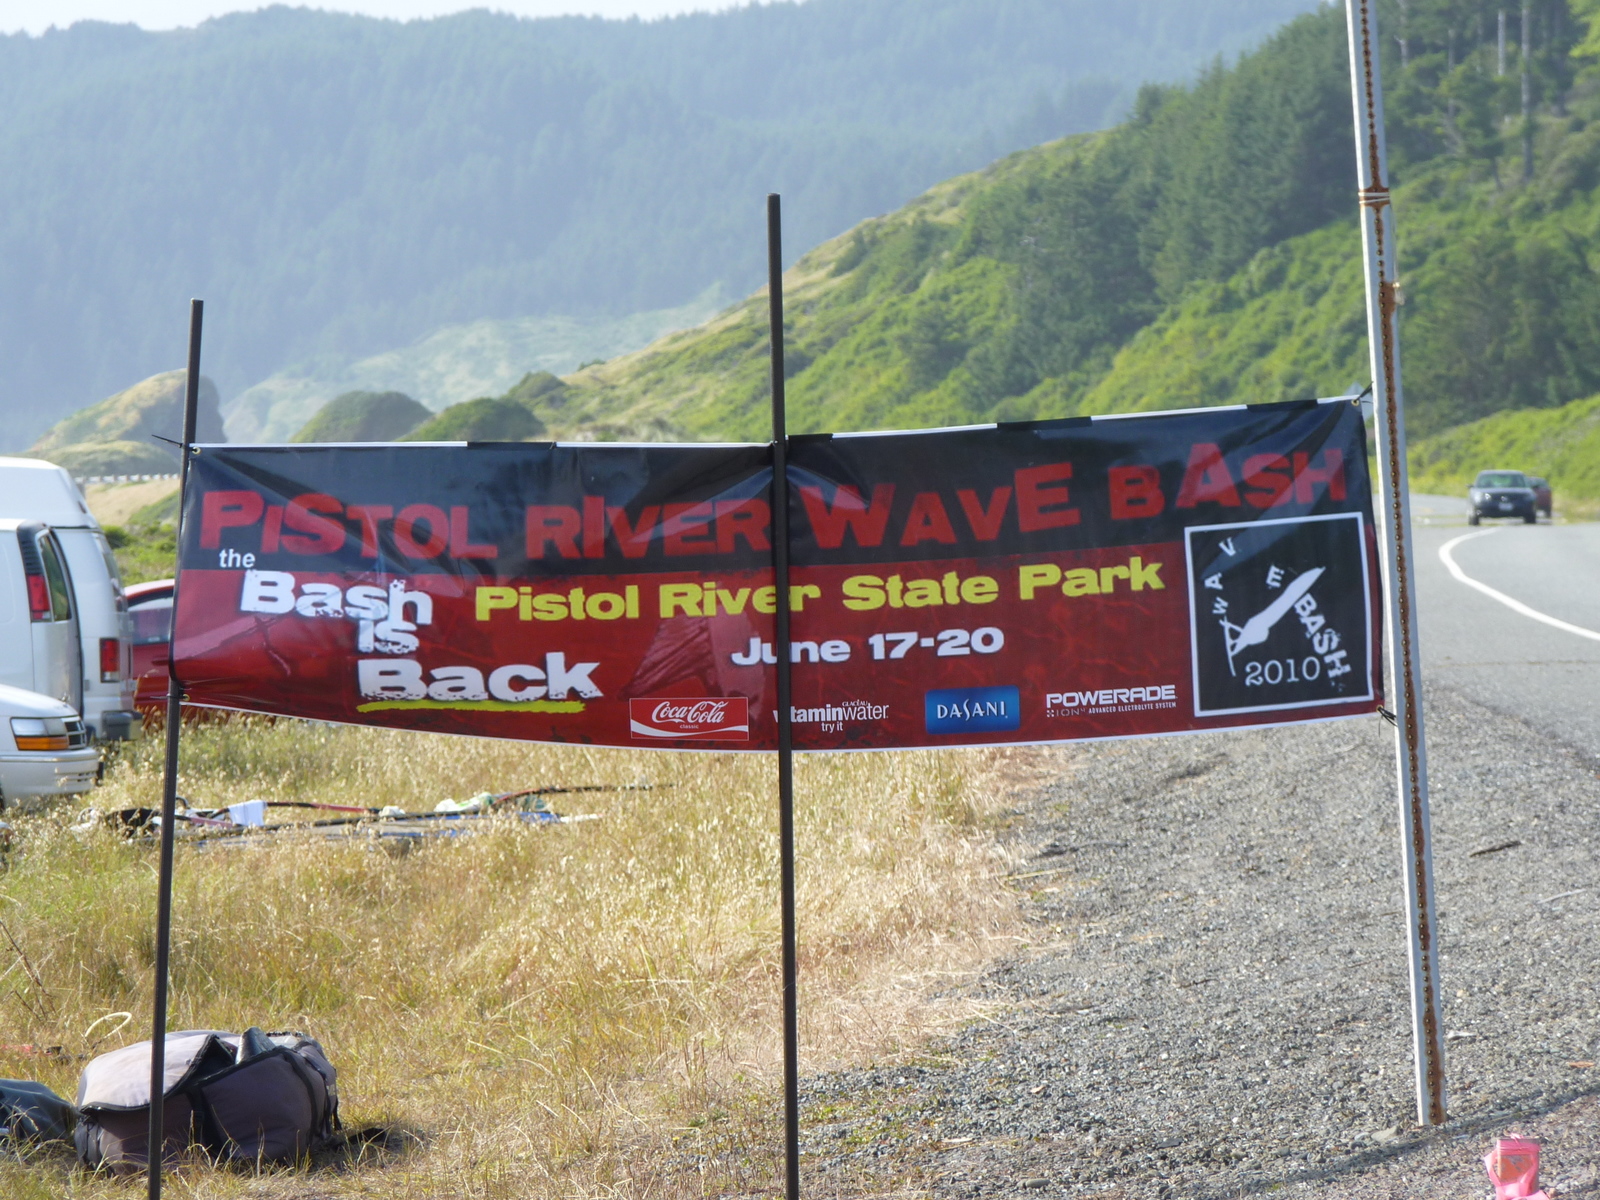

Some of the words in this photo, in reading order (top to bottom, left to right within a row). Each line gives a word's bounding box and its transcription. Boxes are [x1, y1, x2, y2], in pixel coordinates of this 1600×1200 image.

[201, 491, 498, 560] PISTOL
[526, 495, 772, 560] RIVER
[800, 462, 1081, 549] WAVE
[1108, 442, 1347, 520] BASH
[219, 549, 256, 568] the
[240, 569, 433, 626] Bash
[475, 584, 639, 622] Pistol
[659, 581, 821, 619] River
[842, 571, 999, 611] State
[1019, 556, 1165, 600] Park
[731, 637, 851, 666] June
[868, 627, 1004, 660] 17-20
[358, 651, 604, 703] Back
[1245, 656, 1321, 687] 2010
[1046, 684, 1177, 709] POWERADE
[1088, 705, 1117, 714] ADVANCED
[1118, 702, 1154, 712] ELECTROLYTE
[1155, 701, 1177, 709] SYSTEM
[651, 700, 729, 724] Coca-Cola
[773, 702, 889, 723] taminwater
[937, 698, 1005, 721] DASANI
[821, 722, 835, 733] try
[837, 721, 843, 731] it
